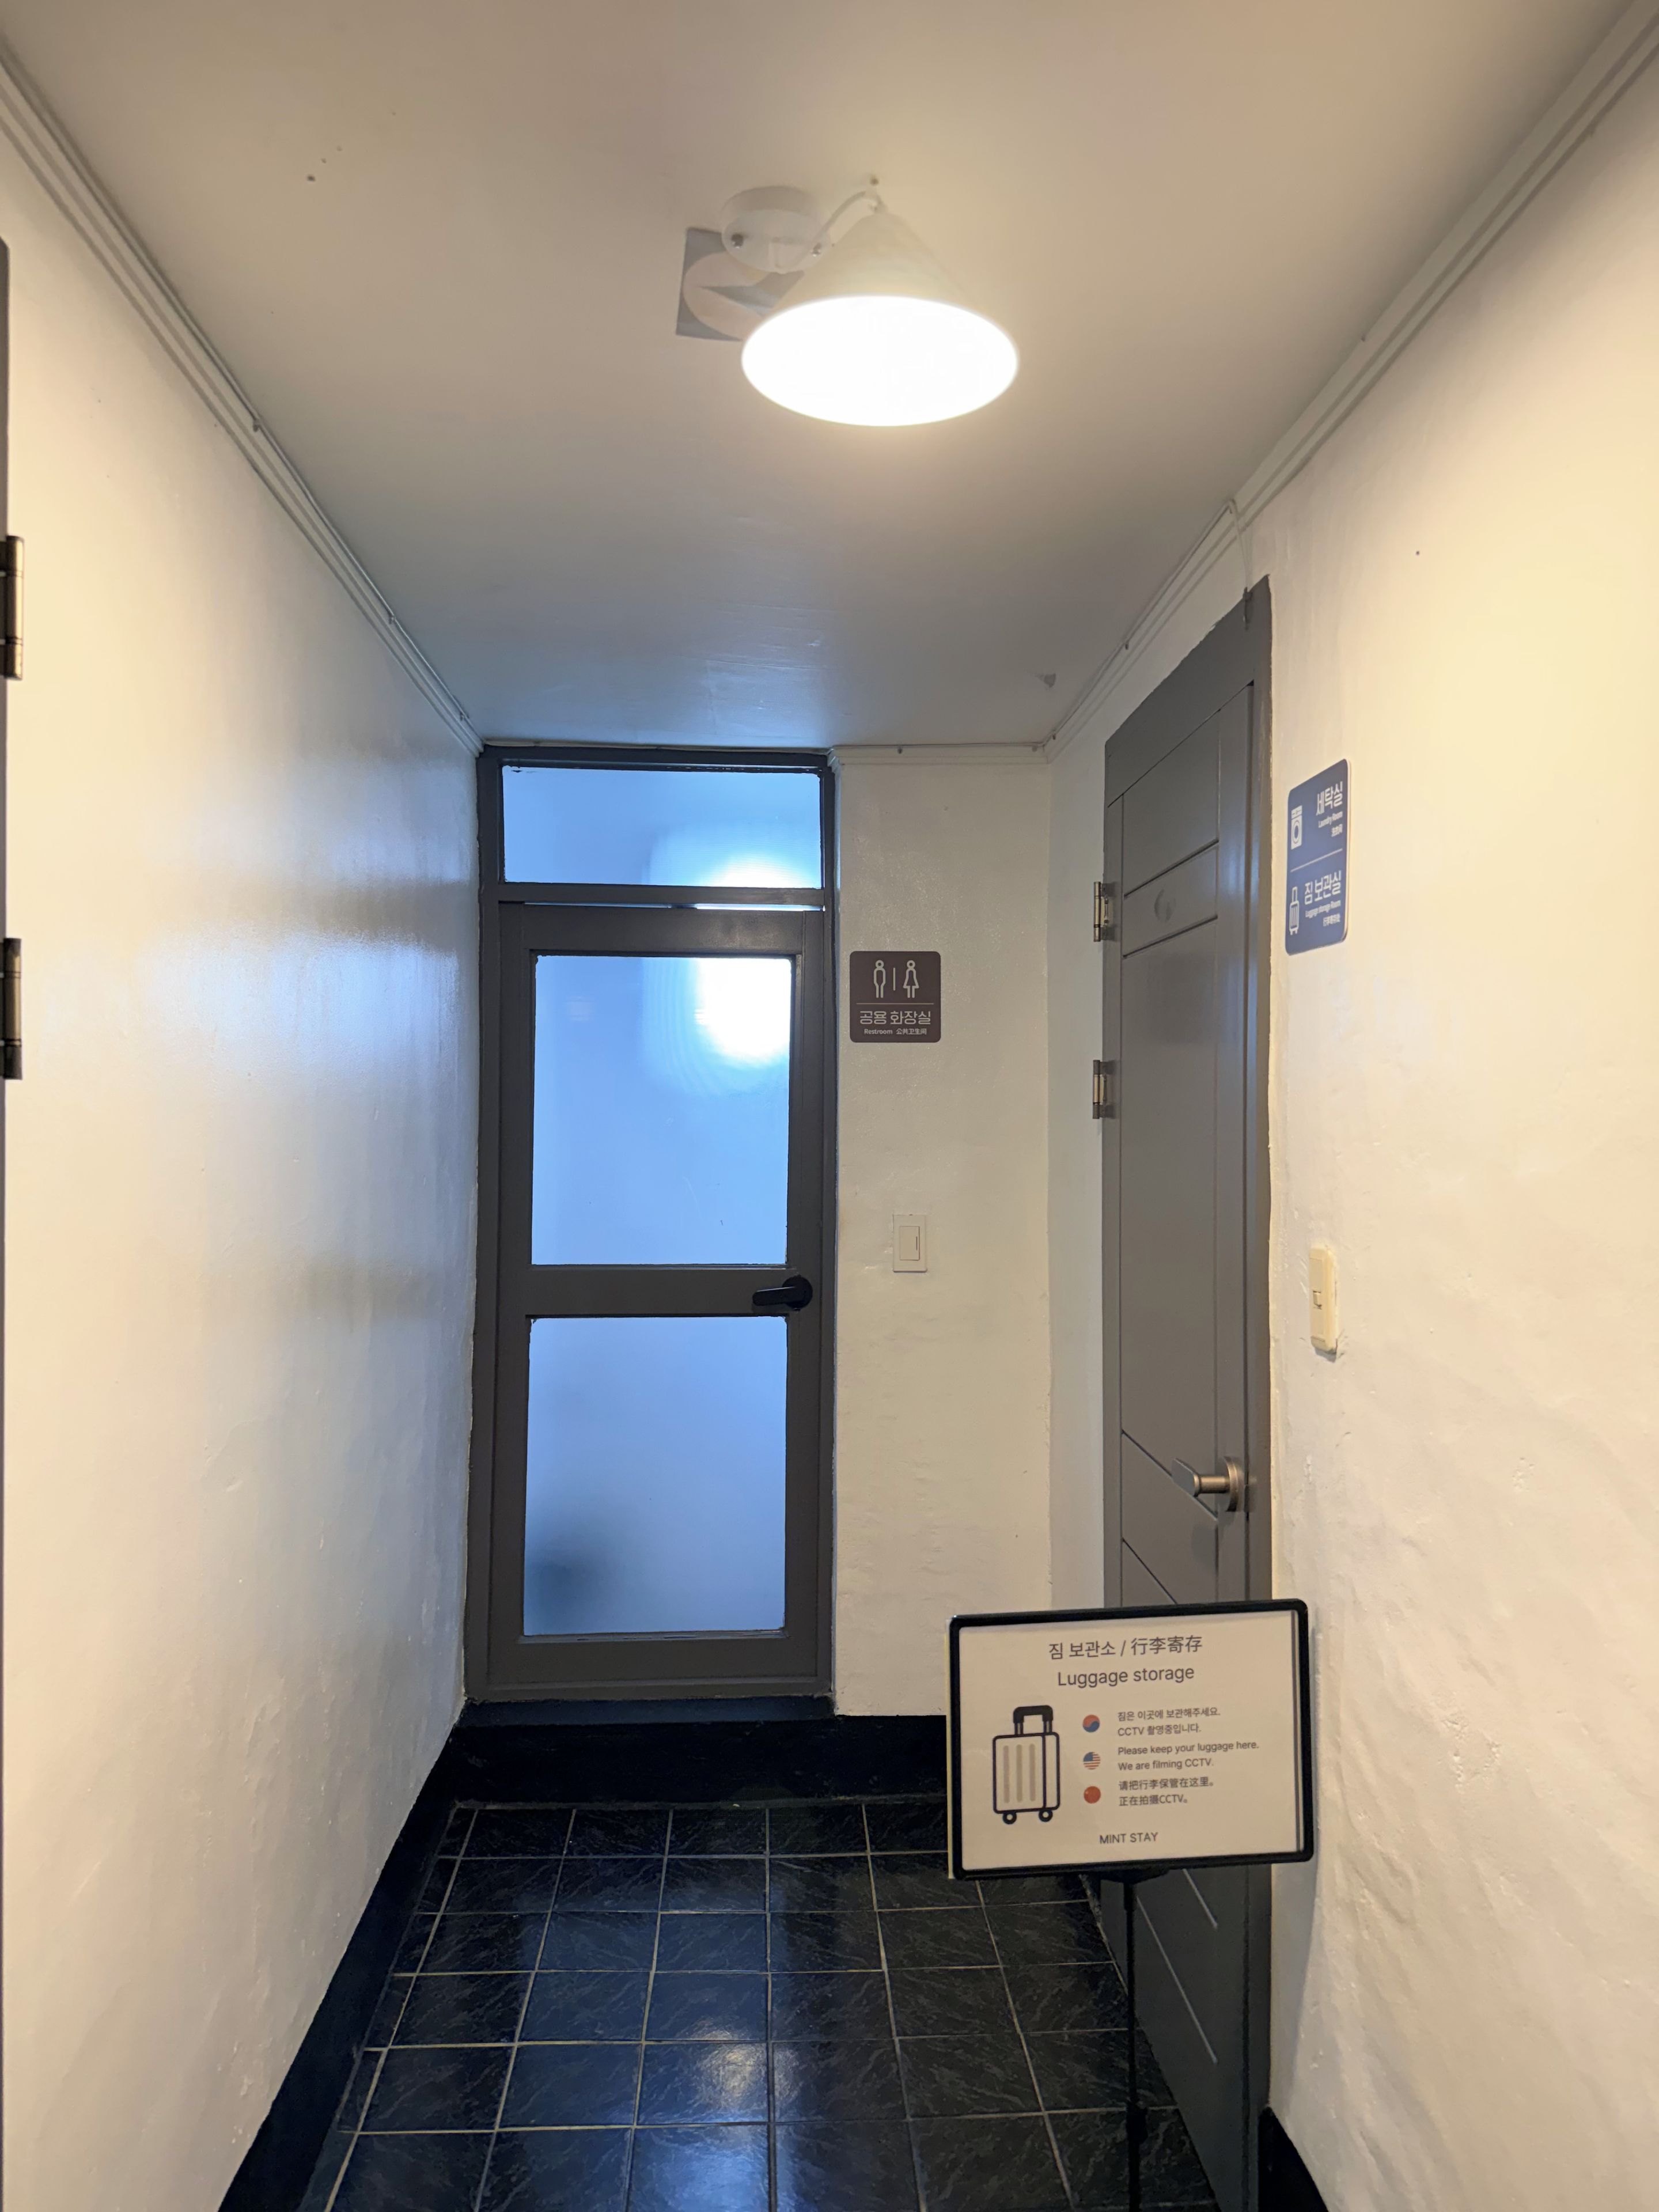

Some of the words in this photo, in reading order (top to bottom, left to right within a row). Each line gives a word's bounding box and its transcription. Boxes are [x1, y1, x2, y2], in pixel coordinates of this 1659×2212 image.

[1316, 781, 1343, 816] 세탁실
[1305, 881, 1313, 905] 짐
[1315, 870, 1342, 902] 보관실
[860, 1011, 887, 1024] 공용
[890, 1011, 931, 1025] 화장실
[1048, 1642, 1063, 1660] 짐
[1069, 1641, 1116, 1658] 보관소
[1120, 1640, 1126, 1657] /
[1131, 1635, 1203, 1656] 行李寄存
[1058, 1672, 1128, 1688] Luggage
[1133, 1668, 1195, 1683] storage
[1118, 1711, 1135, 1722] 짐은
[1138, 1710, 1164, 1720] 이곳에
[1166, 1707, 1221, 1719] 보관해주세요.
[1118, 1727, 1145, 1736] CCTV
[1147, 1723, 1202, 1736] 촬영중입니다.
[1118, 1747, 1147, 1755] Please
[1150, 1745, 1172, 1755] keep
[1175, 1744, 1195, 1754] your
[1198, 1743, 1234, 1752] luggage
[1236, 1741, 1259, 1749] here.
[1118, 1762, 1132, 1770] We
[1135, 1762, 1150, 1770] are
[1153, 1760, 1182, 1769] filming
[1184, 1758, 1214, 1767] CCTV.
[1119, 1777, 1214, 1790] 请把行李保管在这里。
[1119, 1794, 1188, 1806] 正在拍摄CCTV。
[1100, 1834, 1126, 1844] MINT
[1130, 1832, 1158, 1843] STAY
